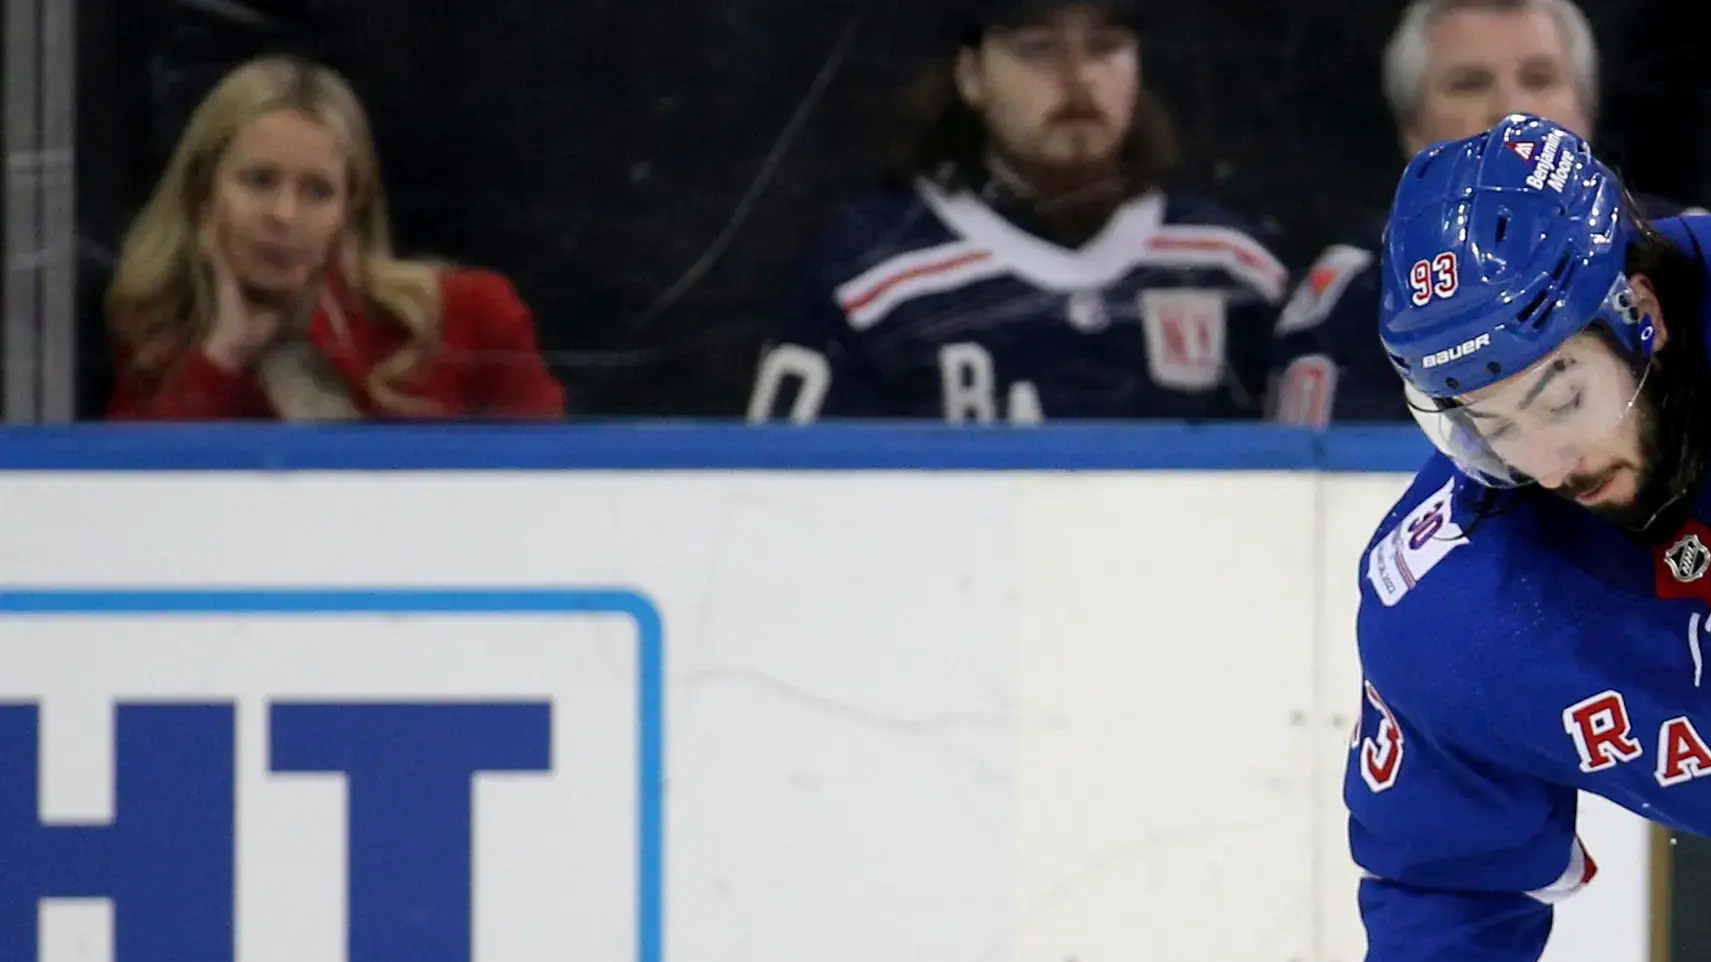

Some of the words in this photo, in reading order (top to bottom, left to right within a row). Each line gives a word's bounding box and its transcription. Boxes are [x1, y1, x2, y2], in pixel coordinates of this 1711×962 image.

[1525, 128, 1564, 190] Benjamin
[1547, 149, 1576, 193] Moore
[1411, 251, 1459, 306] 93
[1422, 332, 1491, 368] BAUER
[1352, 679, 1404, 793] 3
